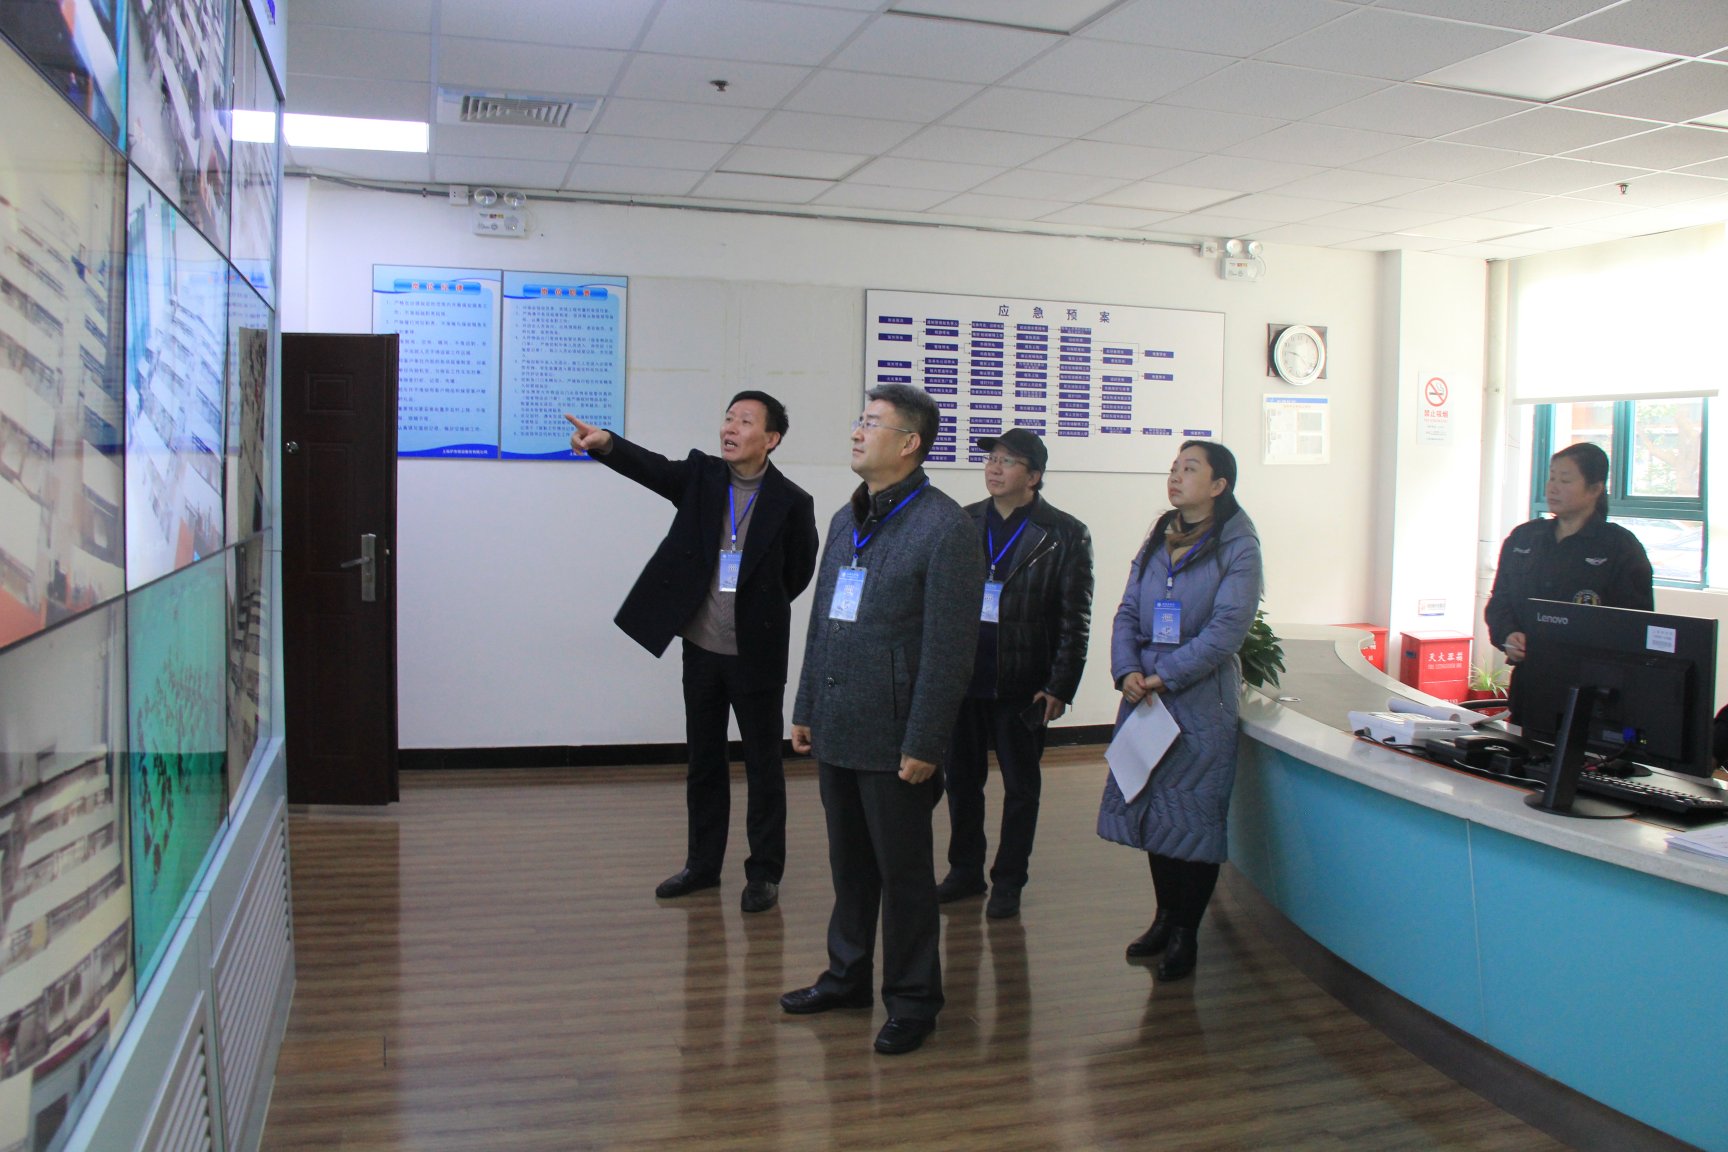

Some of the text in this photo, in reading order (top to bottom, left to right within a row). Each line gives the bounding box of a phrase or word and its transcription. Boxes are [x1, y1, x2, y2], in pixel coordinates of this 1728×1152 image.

[998, 304, 1110, 323] 应急预案
[1537, 612, 1569, 625] Lenovo
